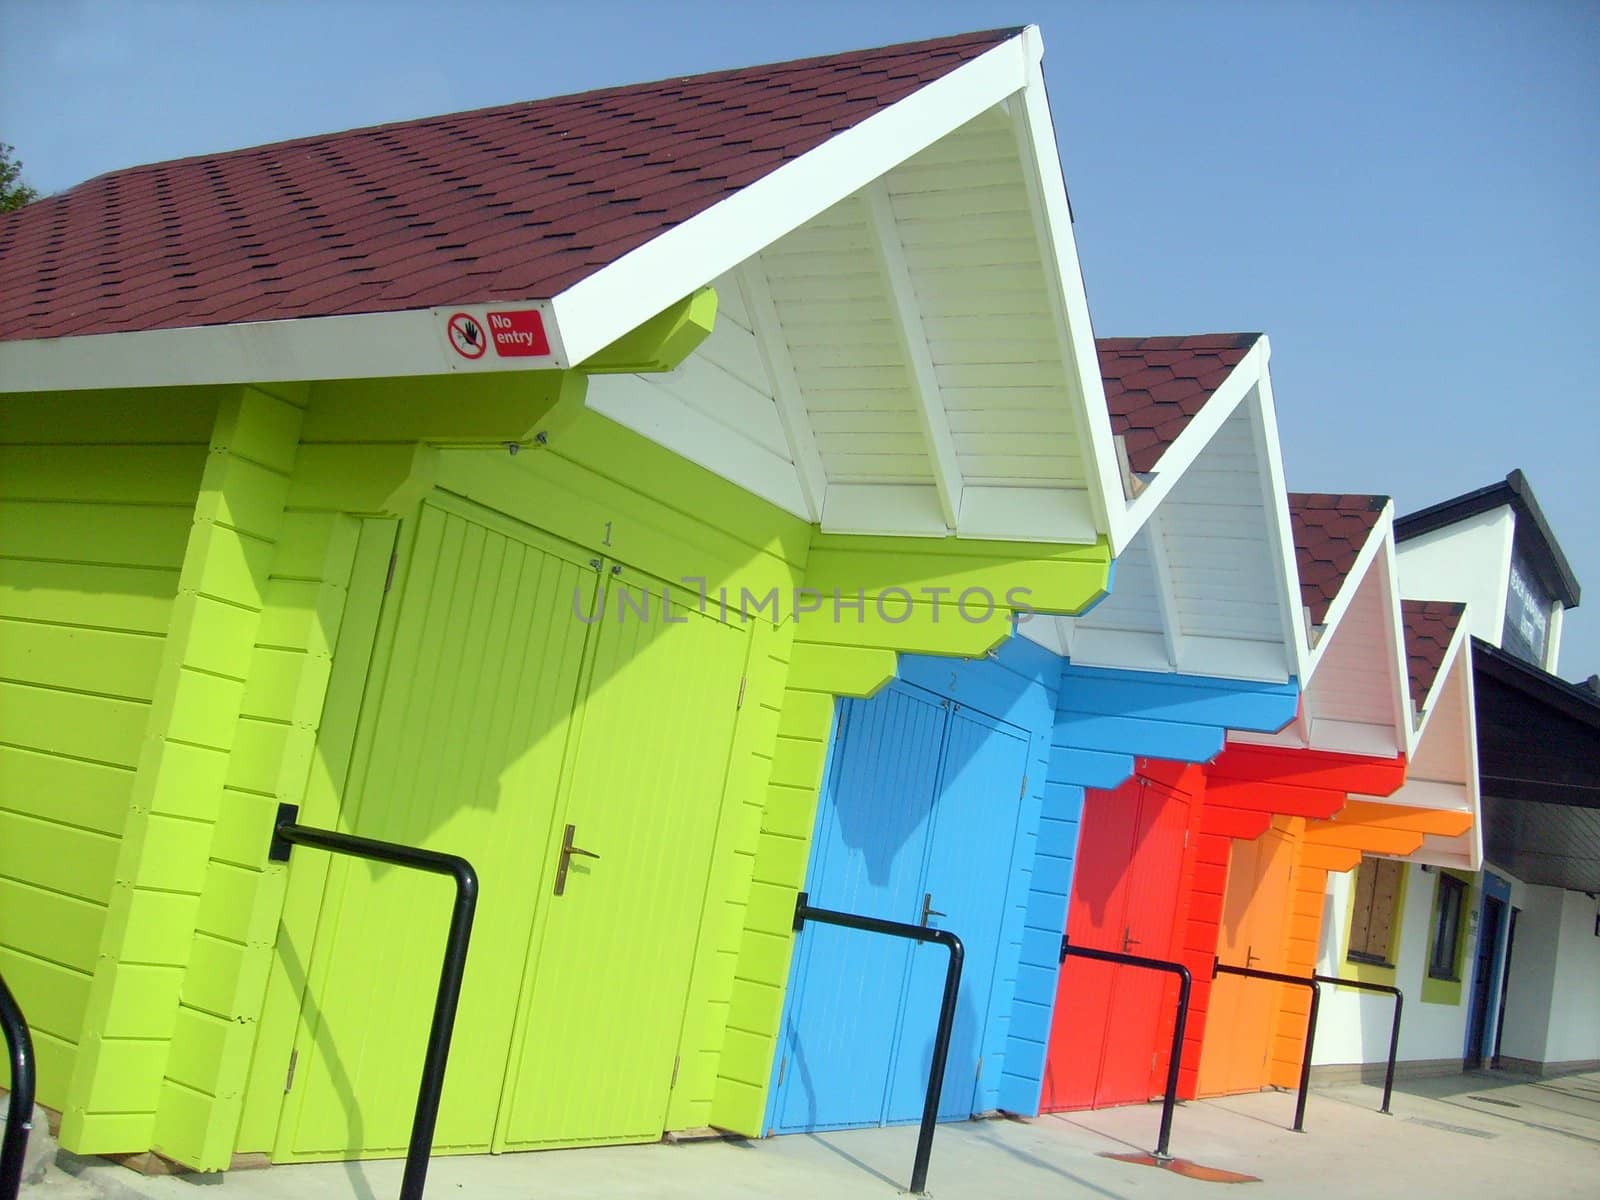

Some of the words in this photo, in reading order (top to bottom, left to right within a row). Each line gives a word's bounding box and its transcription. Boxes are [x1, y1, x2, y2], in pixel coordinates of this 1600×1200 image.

[491, 315, 512, 329] No
[497, 330, 534, 346] entry
[602, 521, 612, 547] 1
